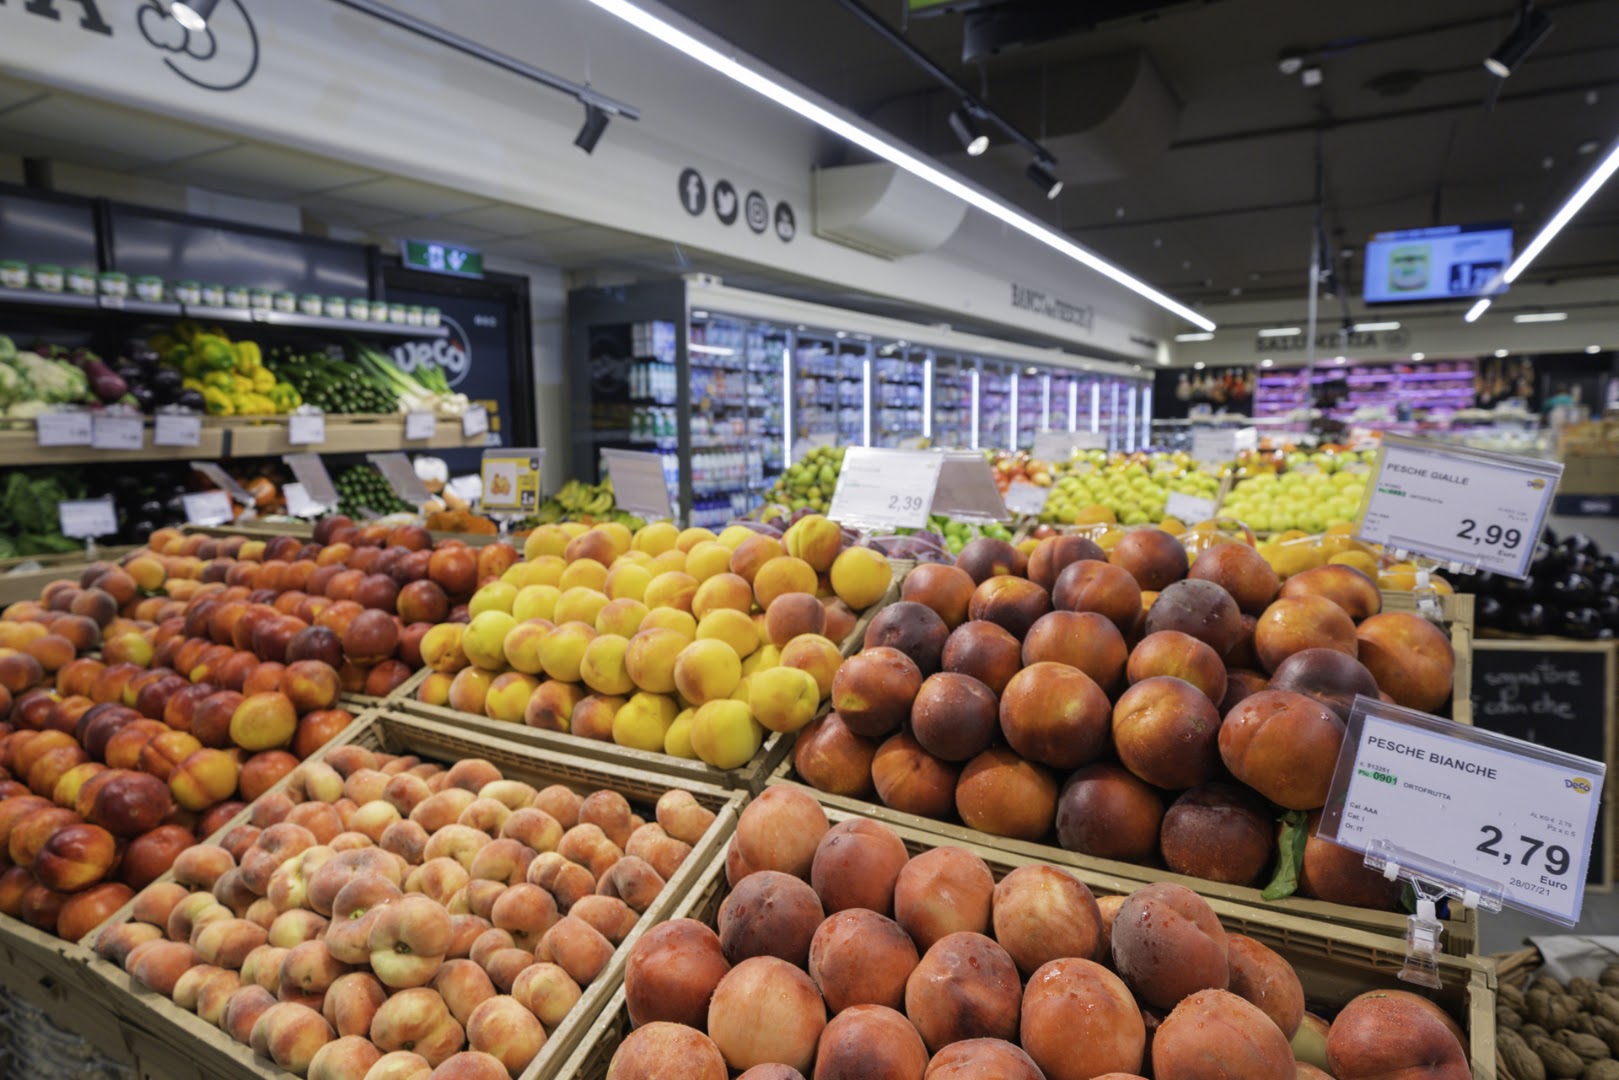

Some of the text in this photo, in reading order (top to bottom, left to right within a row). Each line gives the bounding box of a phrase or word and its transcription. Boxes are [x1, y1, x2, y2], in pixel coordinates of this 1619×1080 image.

[1255, 333, 1379, 353] SALUEIA
[1387, 462, 1470, 486] PESCHE GIALLE
[888, 495, 923, 512] 2,39
[1456, 518, 1522, 549] 2,99
[1367, 735, 1498, 780] PESCHE BIANCHE
[1373, 771, 1398, 785] 0901
[1403, 782, 1451, 800] ORTOFRUTTA
[1363, 806, 1378, 815] AAA
[1476, 825, 1570, 876] 2,79
[1509, 877, 1550, 896] 28/07/21
[1540, 875, 1568, 891] Euro
